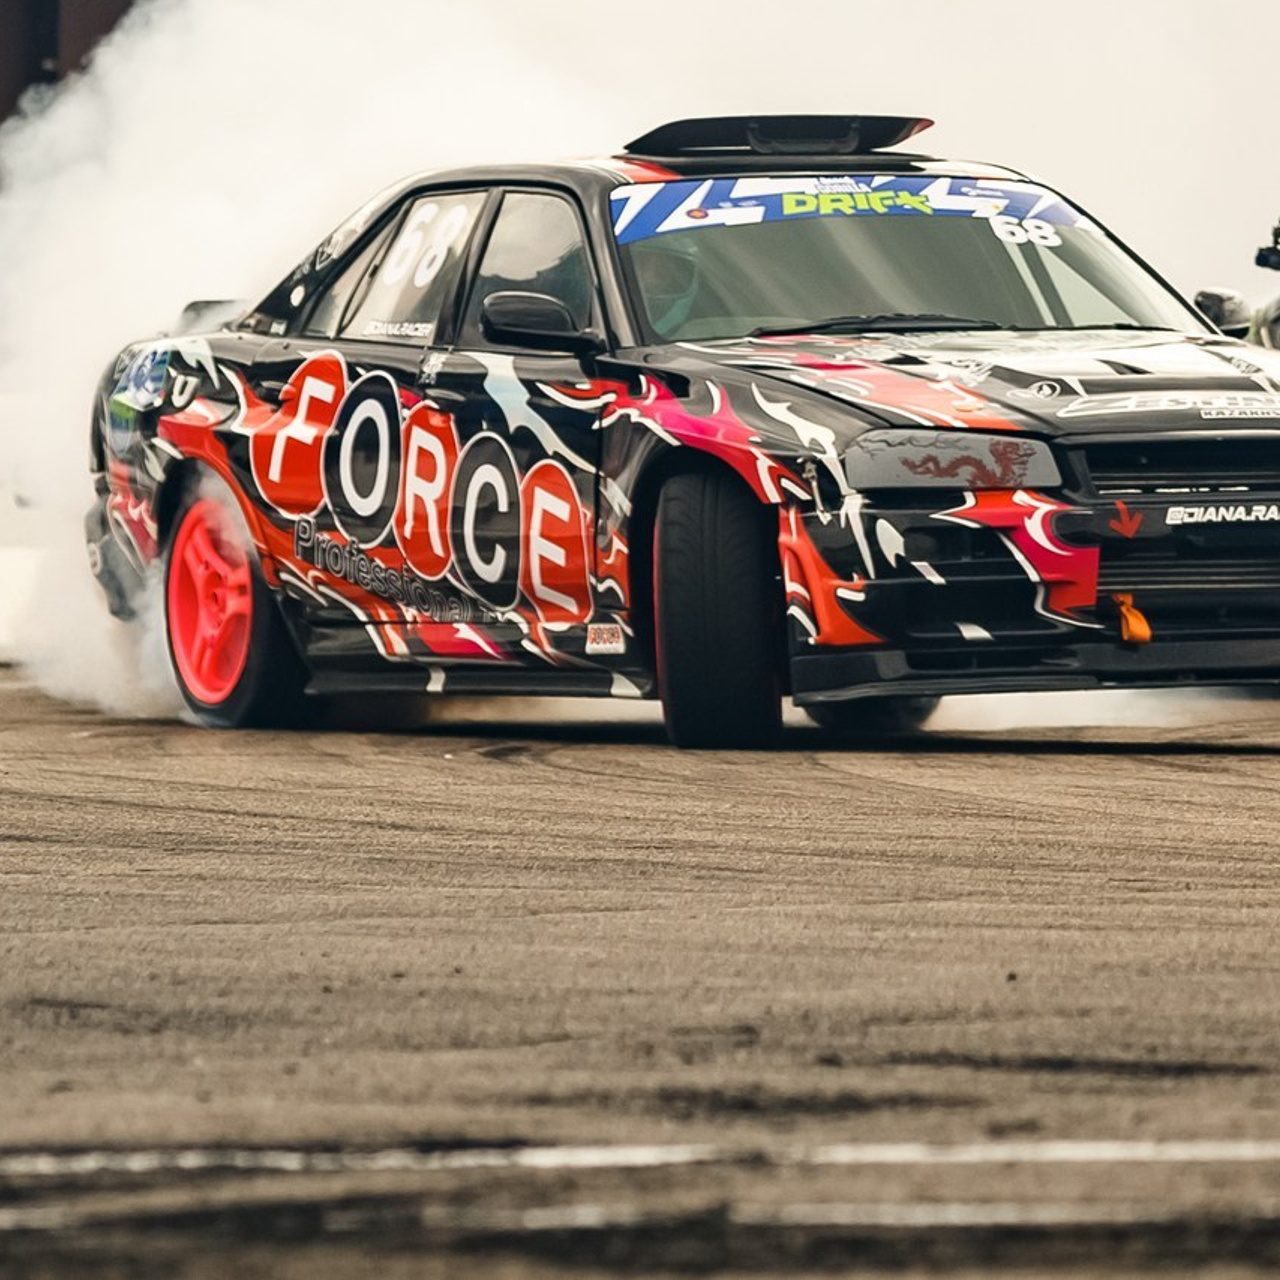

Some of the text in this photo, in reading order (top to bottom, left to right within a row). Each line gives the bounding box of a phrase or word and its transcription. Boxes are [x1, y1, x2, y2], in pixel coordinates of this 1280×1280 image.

[383, 203, 467, 287] 68
[989, 216, 1063, 247] 68
[267, 377, 580, 616] FORCE
[294, 516, 473, 623] Professional
